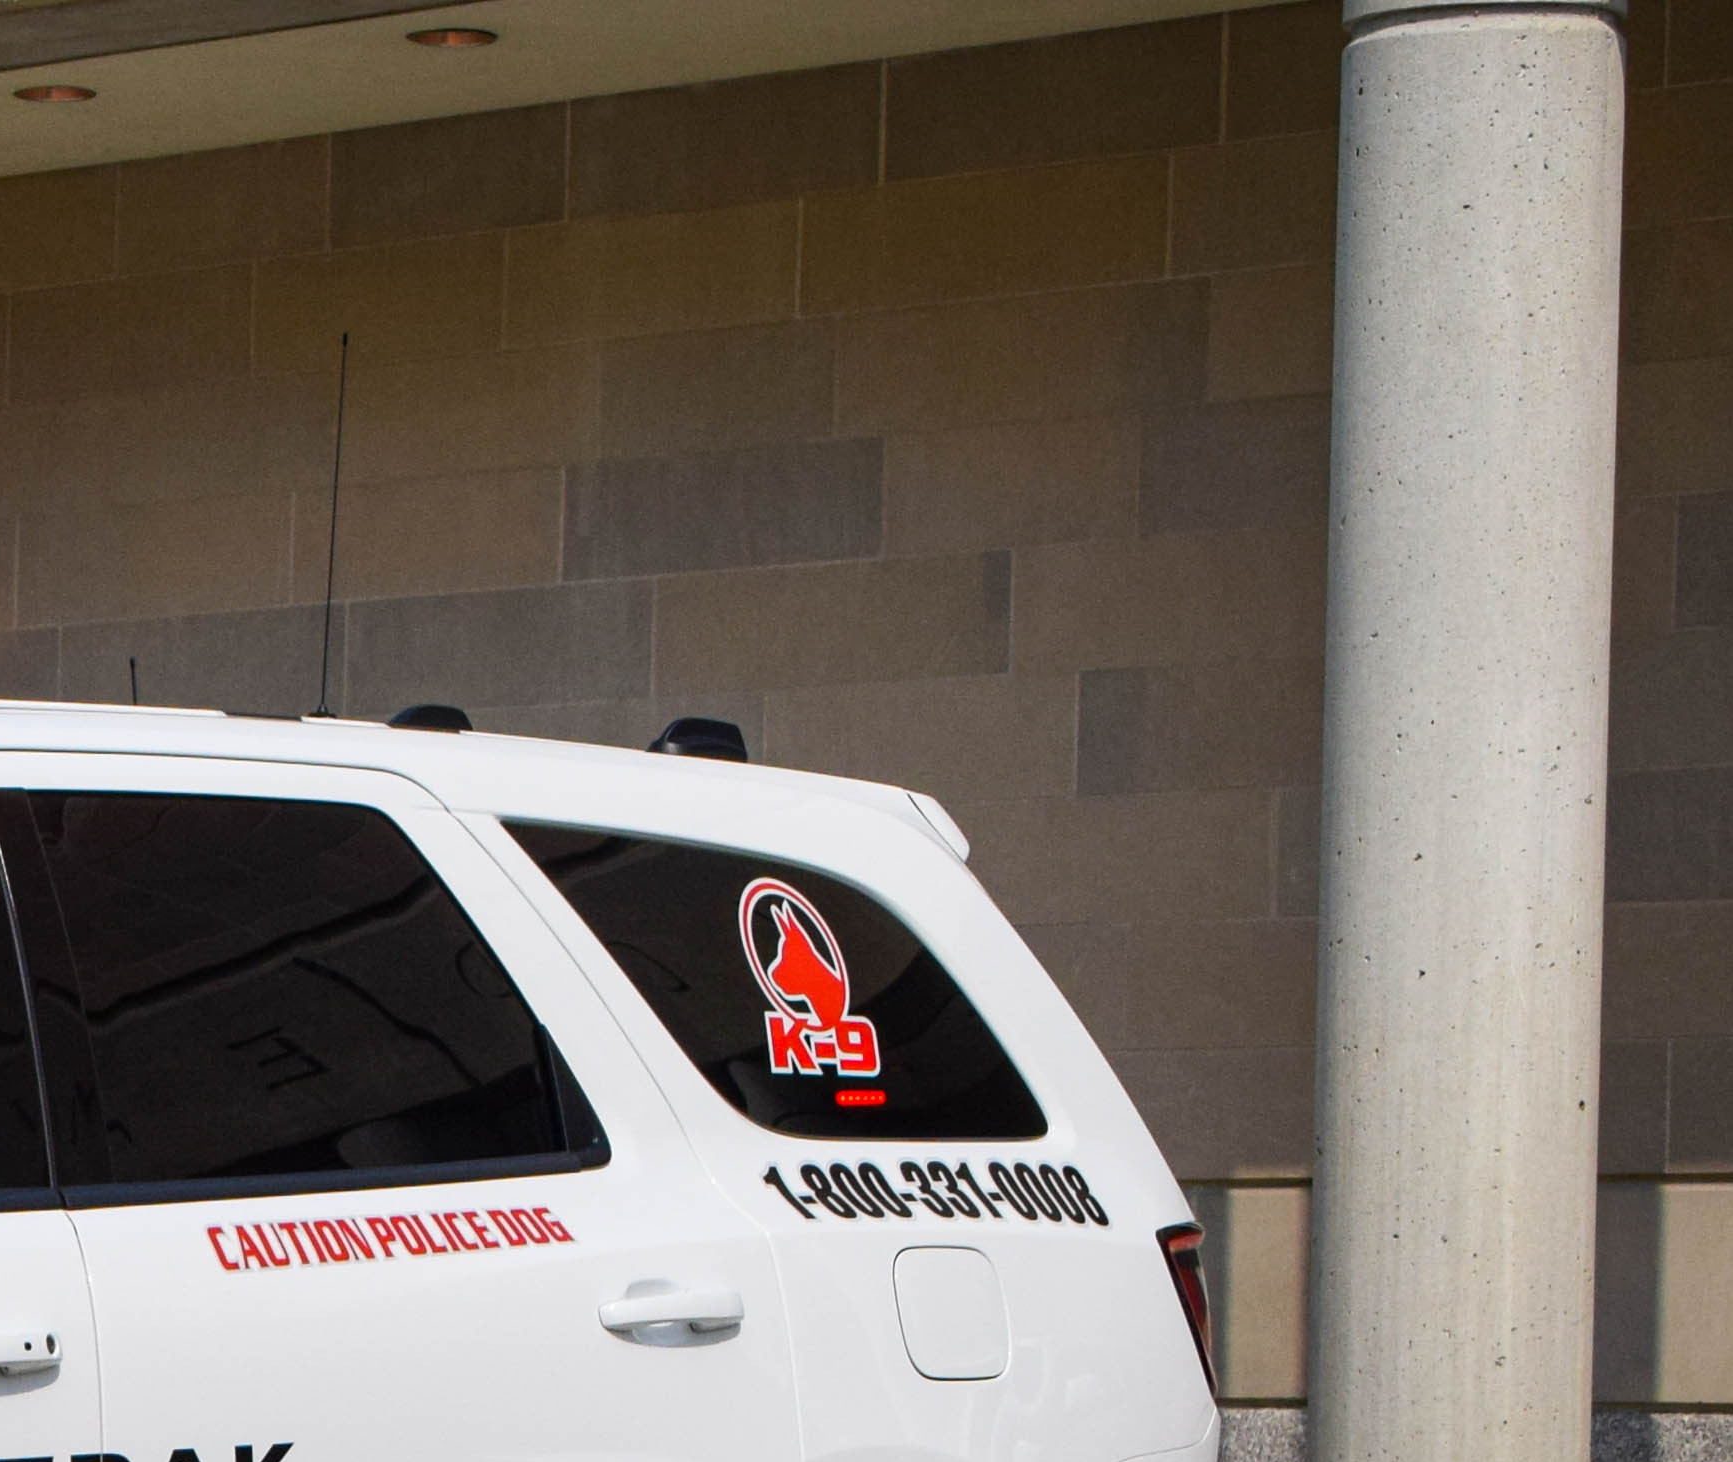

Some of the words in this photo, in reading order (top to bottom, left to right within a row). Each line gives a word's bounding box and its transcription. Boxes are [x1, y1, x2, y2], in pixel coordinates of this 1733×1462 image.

[764, 1010, 880, 1077] K-9
[762, 1161, 1110, 1227] 1-800-331-0008
[206, 1218, 375, 1270] CAUTION
[365, 1211, 501, 1257] POLICE
[487, 1207, 576, 1247] DOG
